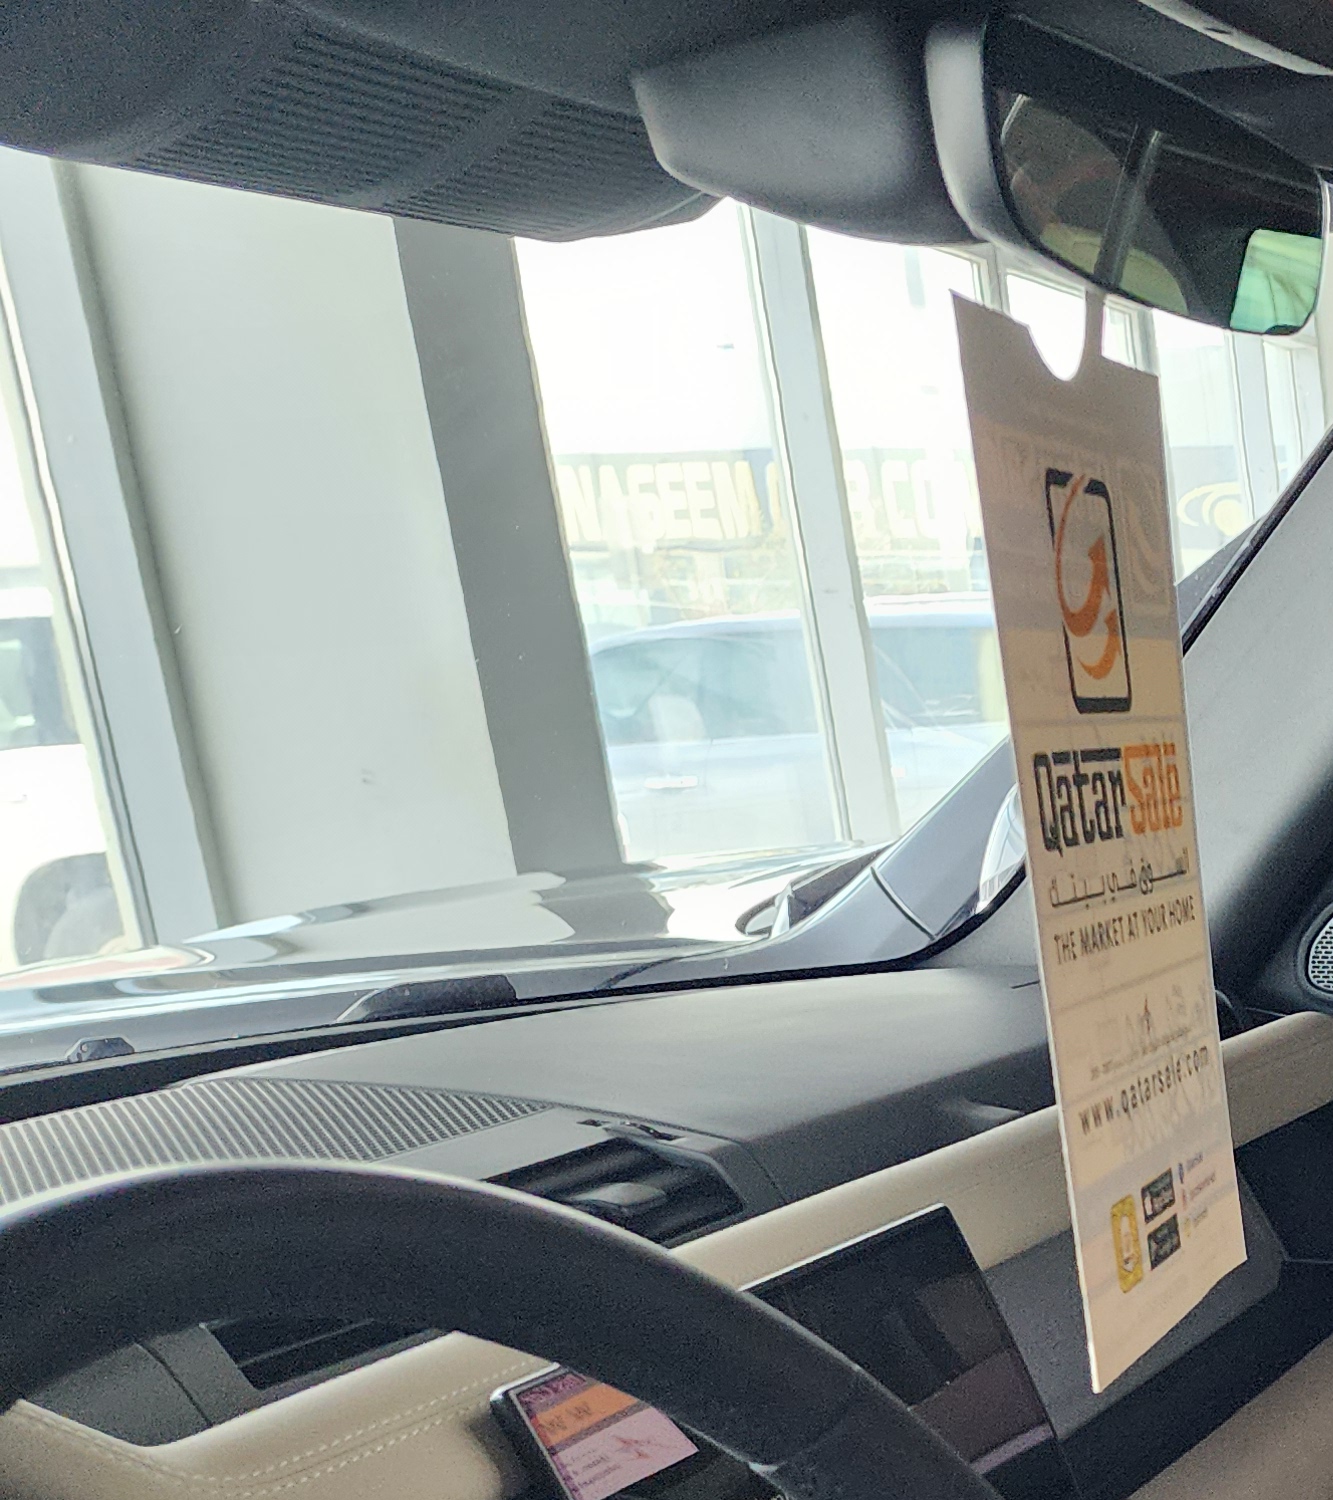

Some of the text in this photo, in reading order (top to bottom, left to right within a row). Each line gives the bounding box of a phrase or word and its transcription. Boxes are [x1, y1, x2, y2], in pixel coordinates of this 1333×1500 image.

[1053, 894, 1196, 966] THE MARKET AT YOUR HOME
[1078, 1044, 1209, 1137] www.qatarsale.com
